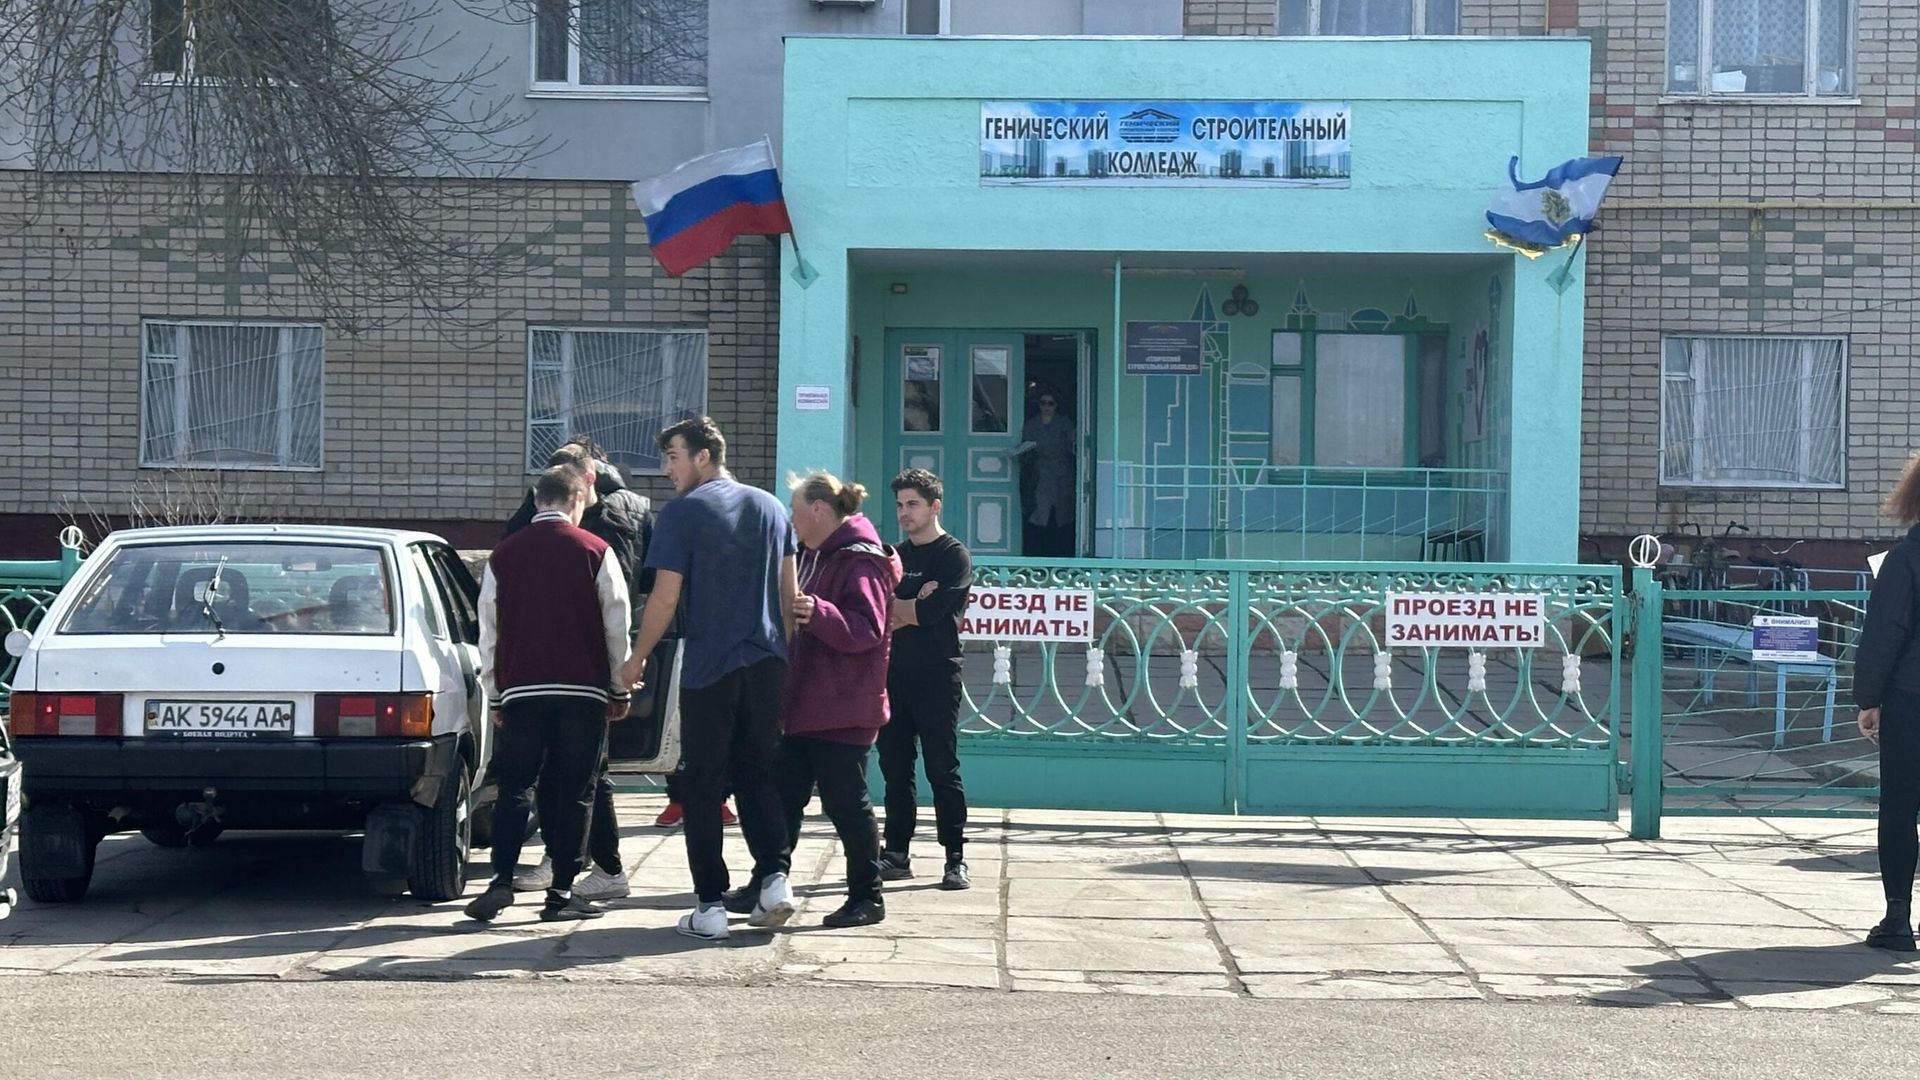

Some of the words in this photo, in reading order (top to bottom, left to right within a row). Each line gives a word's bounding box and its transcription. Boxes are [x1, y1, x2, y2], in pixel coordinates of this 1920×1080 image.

[985, 112, 1109, 140] ГЕНИЧЕСКИЙ
[1192, 112, 1346, 140] СТРОИТЕЛЬНЫЙ
[1108, 151, 1197, 176] КОЛЛЕДЖ
[966, 593, 1047, 614] РОЕЗД
[1055, 595, 1088, 611] НЕ
[1393, 599, 1497, 619] ПРОЕЗД
[1504, 600, 1538, 617] НЕ
[958, 618, 1089, 637] АНИМАТЬ!
[1391, 624, 1540, 642] ЗАНИМАТЬ!
[161, 706, 192, 727] AK
[199, 706, 248, 728] 5944
[253, 706, 285, 728] AA
